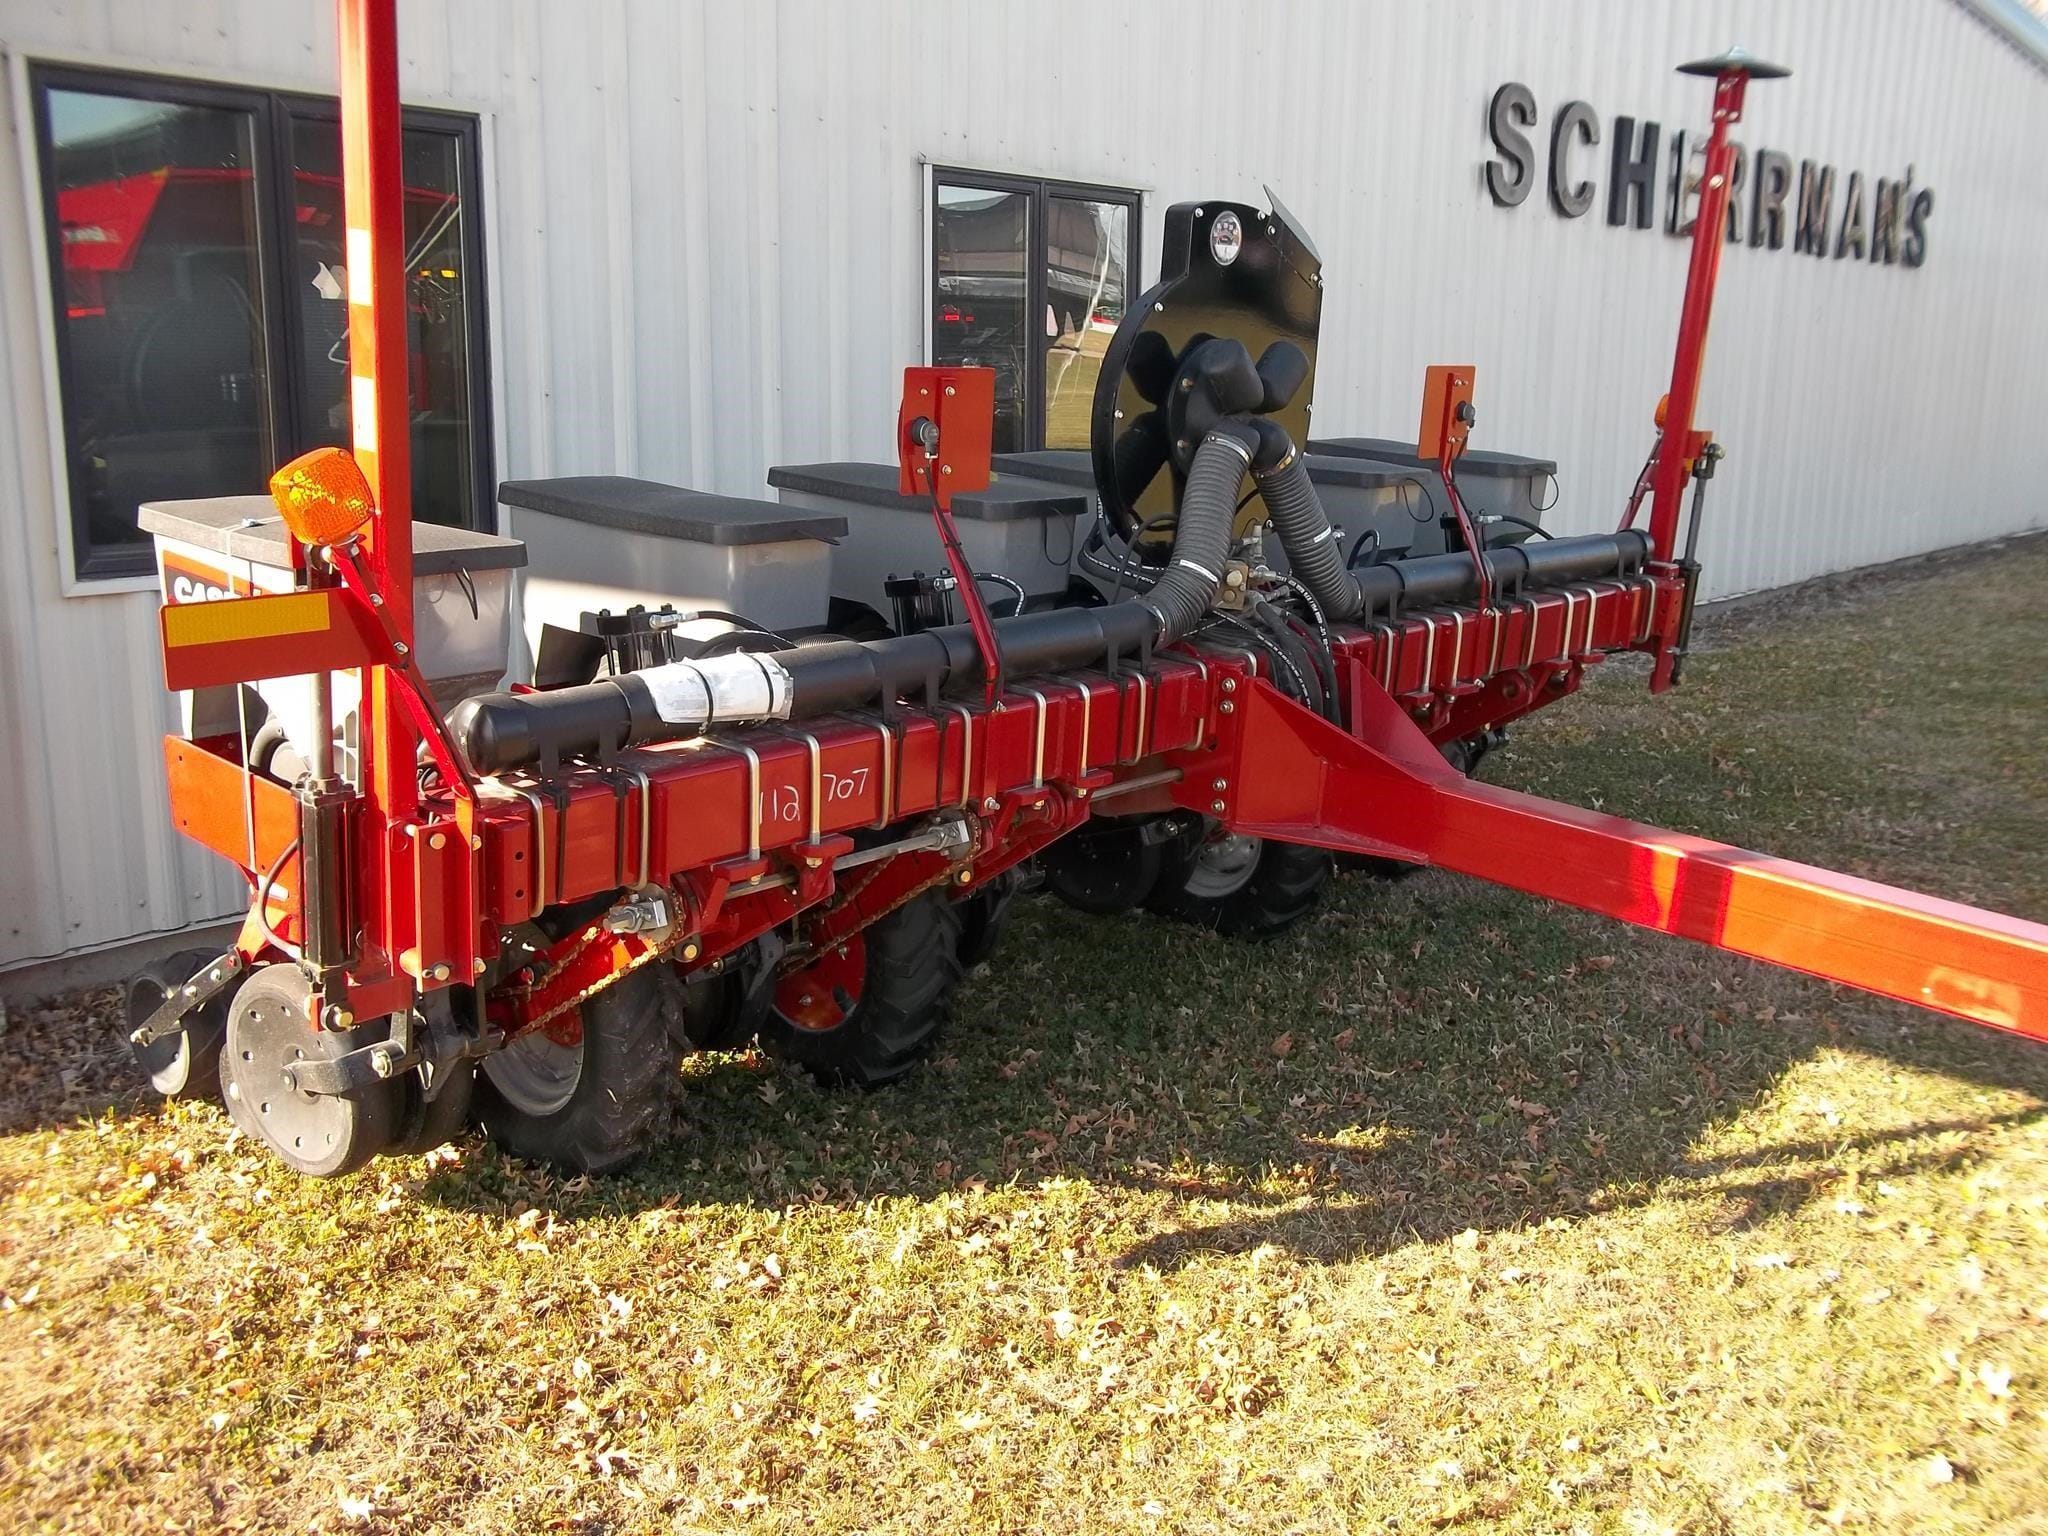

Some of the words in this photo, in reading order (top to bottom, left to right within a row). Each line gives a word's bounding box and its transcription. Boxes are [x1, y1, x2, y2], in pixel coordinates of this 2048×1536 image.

[174, 576, 242, 605] CA
[759, 785, 800, 824] 112
[823, 768, 869, 802] 707
